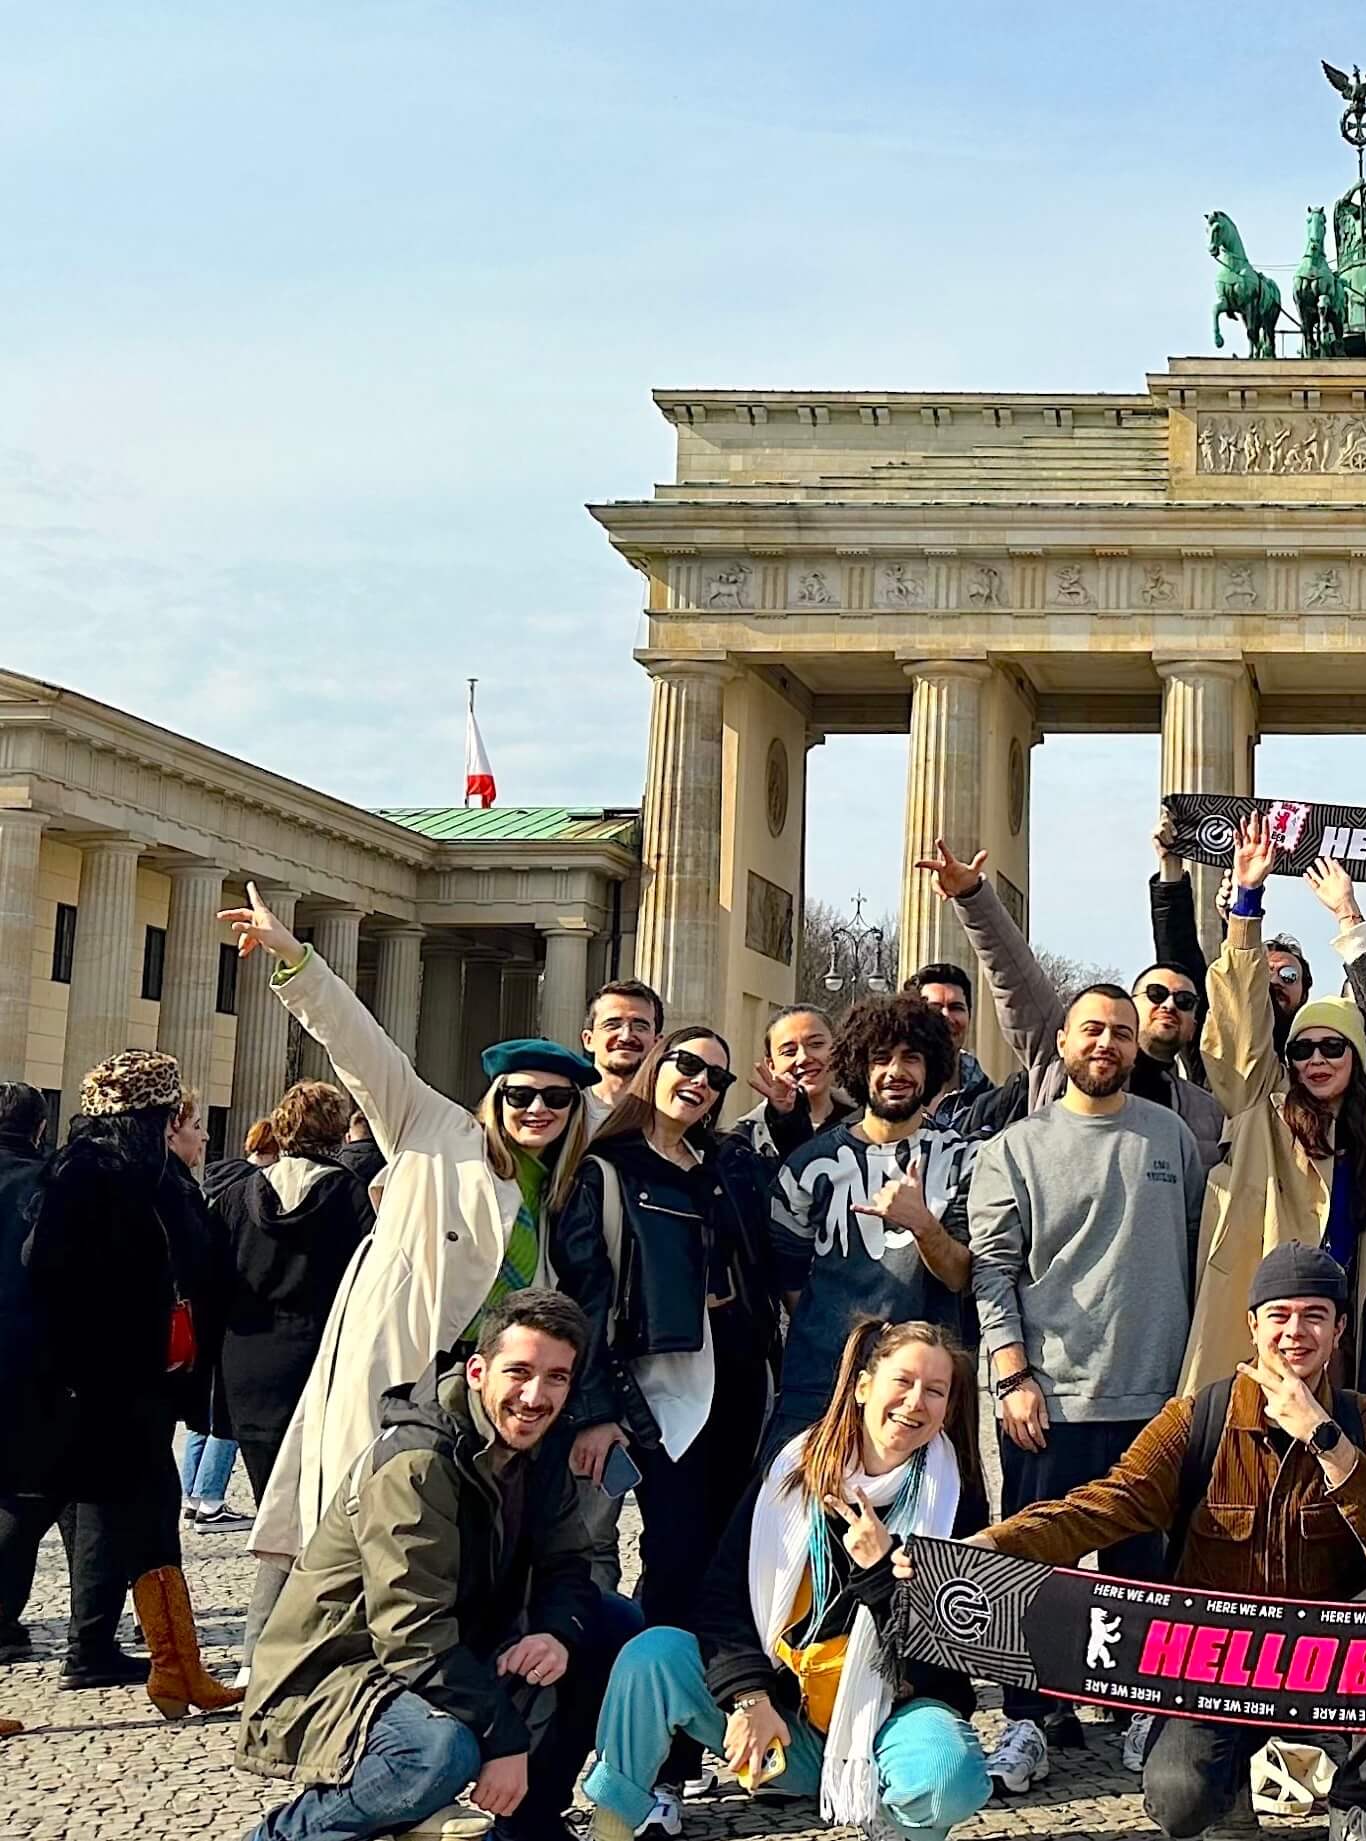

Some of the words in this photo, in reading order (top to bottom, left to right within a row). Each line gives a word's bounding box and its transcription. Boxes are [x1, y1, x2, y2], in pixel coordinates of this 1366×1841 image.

[1093, 1583, 1126, 1599] HERE
[1126, 1588, 1146, 1602] WE
[1145, 1591, 1171, 1606] ARE
[1206, 1599, 1238, 1615] HERE
[1239, 1603, 1258, 1617] WE
[1258, 1605, 1284, 1619] ARE
[1320, 1610, 1352, 1624] HERE
[1138, 1619, 1339, 1694] HELLO
[1084, 1679, 1109, 1694] ARE
[1110, 1683, 1129, 1698] WE
[1129, 1686, 1161, 1703] HERE
[1197, 1696, 1222, 1710] ARE
[1223, 1699, 1242, 1713] WE
[1243, 1701, 1275, 1716] HERE
[1312, 1707, 1338, 1721] ARE
[1338, 1708, 1357, 1721] WE
